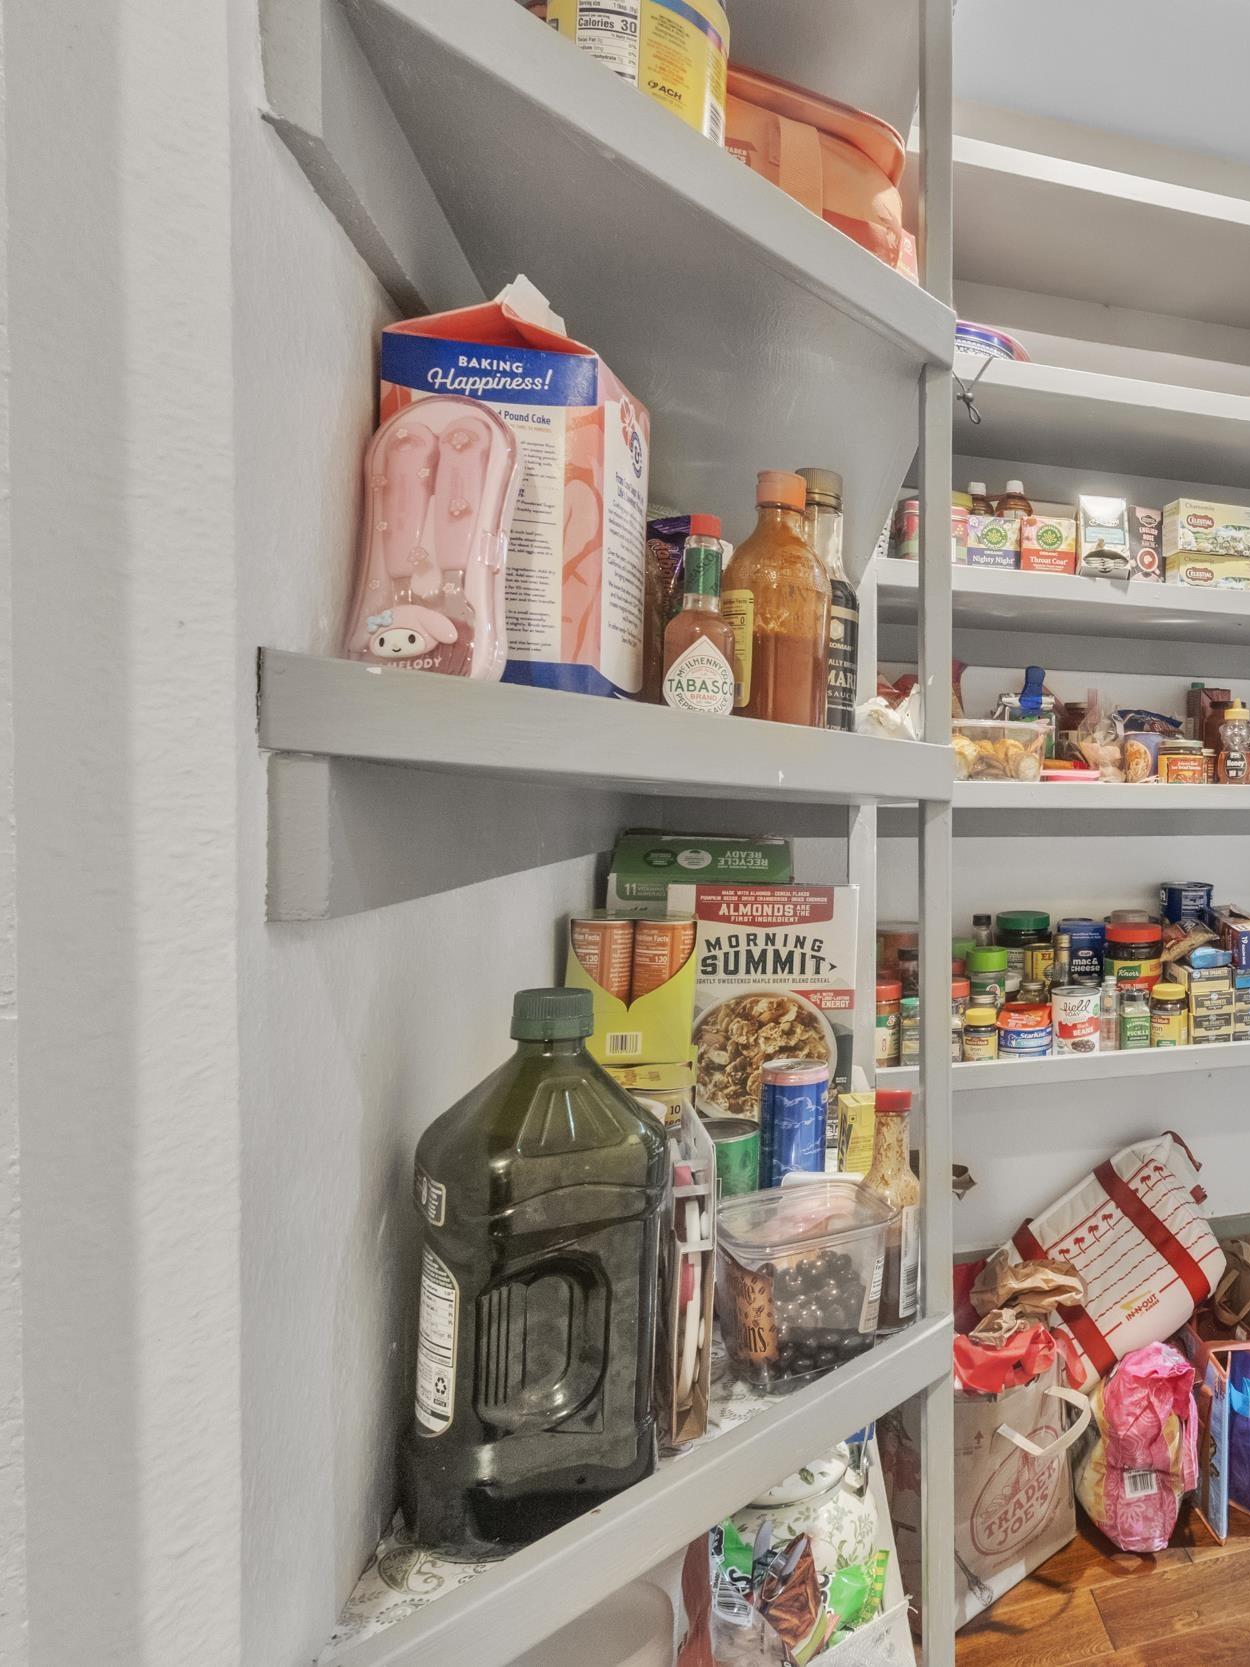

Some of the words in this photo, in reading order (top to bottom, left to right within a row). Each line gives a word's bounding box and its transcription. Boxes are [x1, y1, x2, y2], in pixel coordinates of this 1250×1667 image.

[578, 17, 615, 29] Calories
[621, 19, 638, 34] 30
[658, 86, 682, 100] ACH
[457, 355, 523, 373] BAKING
[427, 367, 553, 396] Happiness!
[503, 410, 530, 423] Pound
[531, 412, 552, 426] Cake
[1187, 515, 1213, 526] CELESTIAL
[972, 554, 995, 563] Nighty
[995, 556, 1015, 565] Night
[1029, 556, 1051, 564] Throat
[1051, 558, 1068, 566] Coat
[1186, 568, 1213, 579] CELESTIAL
[690, 693, 718, 701] BRAND
[1226, 759, 1245, 769] Honey
[724, 850, 763, 859] READY
[718, 857, 769, 867] RECYCLE
[623, 883, 638, 896] 11
[719, 903, 794, 916] ALMONDS
[704, 932, 824, 953] MORNING
[584, 954, 599, 963] 130
[654, 955, 668, 964] 130
[700, 948, 826, 976] SUMMIT
[1117, 969, 1139, 977] Knorr
[821, 1000, 850, 1009] ENERGY
[1072, 1027, 1095, 1037] BEANS
[669, 1104, 681, 1115] 10
[1124, 1292, 1158, 1322] IN-N-OUT
[983, 1461, 1057, 1540] TRADER
[996, 1485, 1050, 1547] JOE'S
